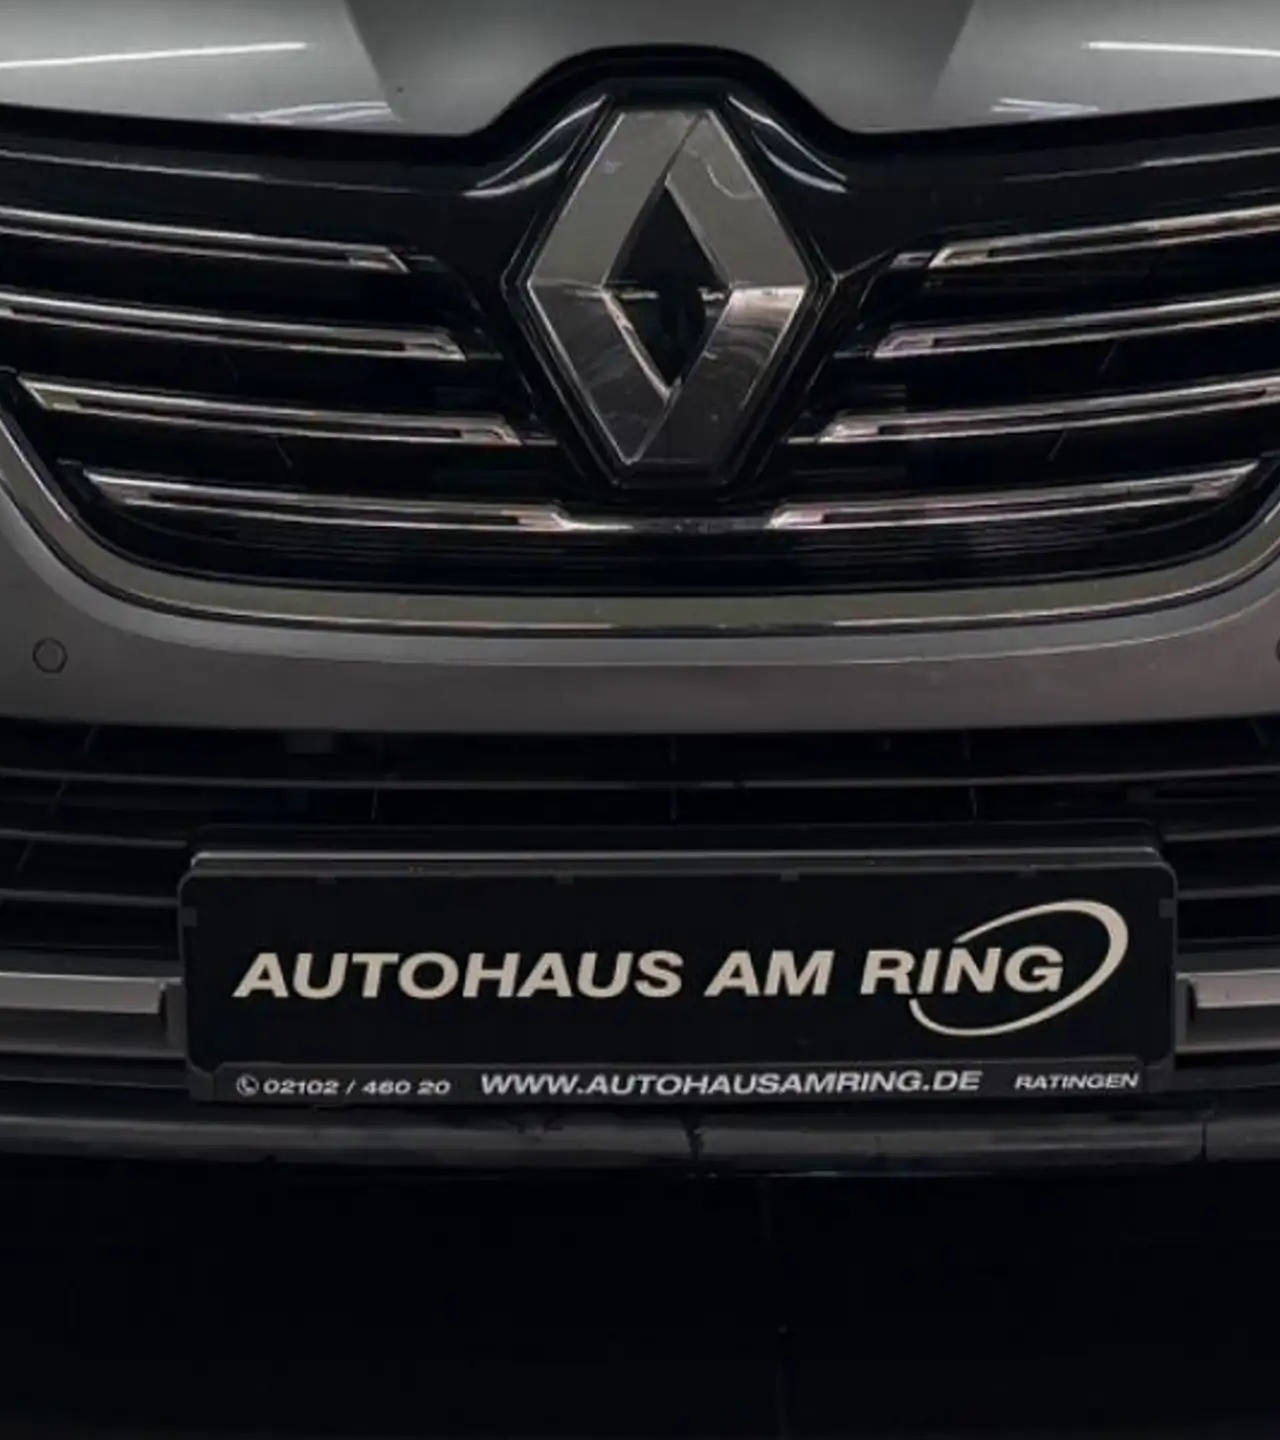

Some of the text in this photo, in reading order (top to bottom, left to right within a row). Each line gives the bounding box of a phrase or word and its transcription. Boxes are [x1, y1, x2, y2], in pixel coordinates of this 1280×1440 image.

[233, 945, 1064, 999] AUTOHAUS AM RING
[262, 1079, 339, 1095] 02102
[361, 1079, 412, 1095] 460
[416, 1079, 451, 1095] 20
[480, 1070, 983, 1096] WWW.AUTOHAUSAMRING.DE
[1014, 1072, 1140, 1090] RATINGEN
